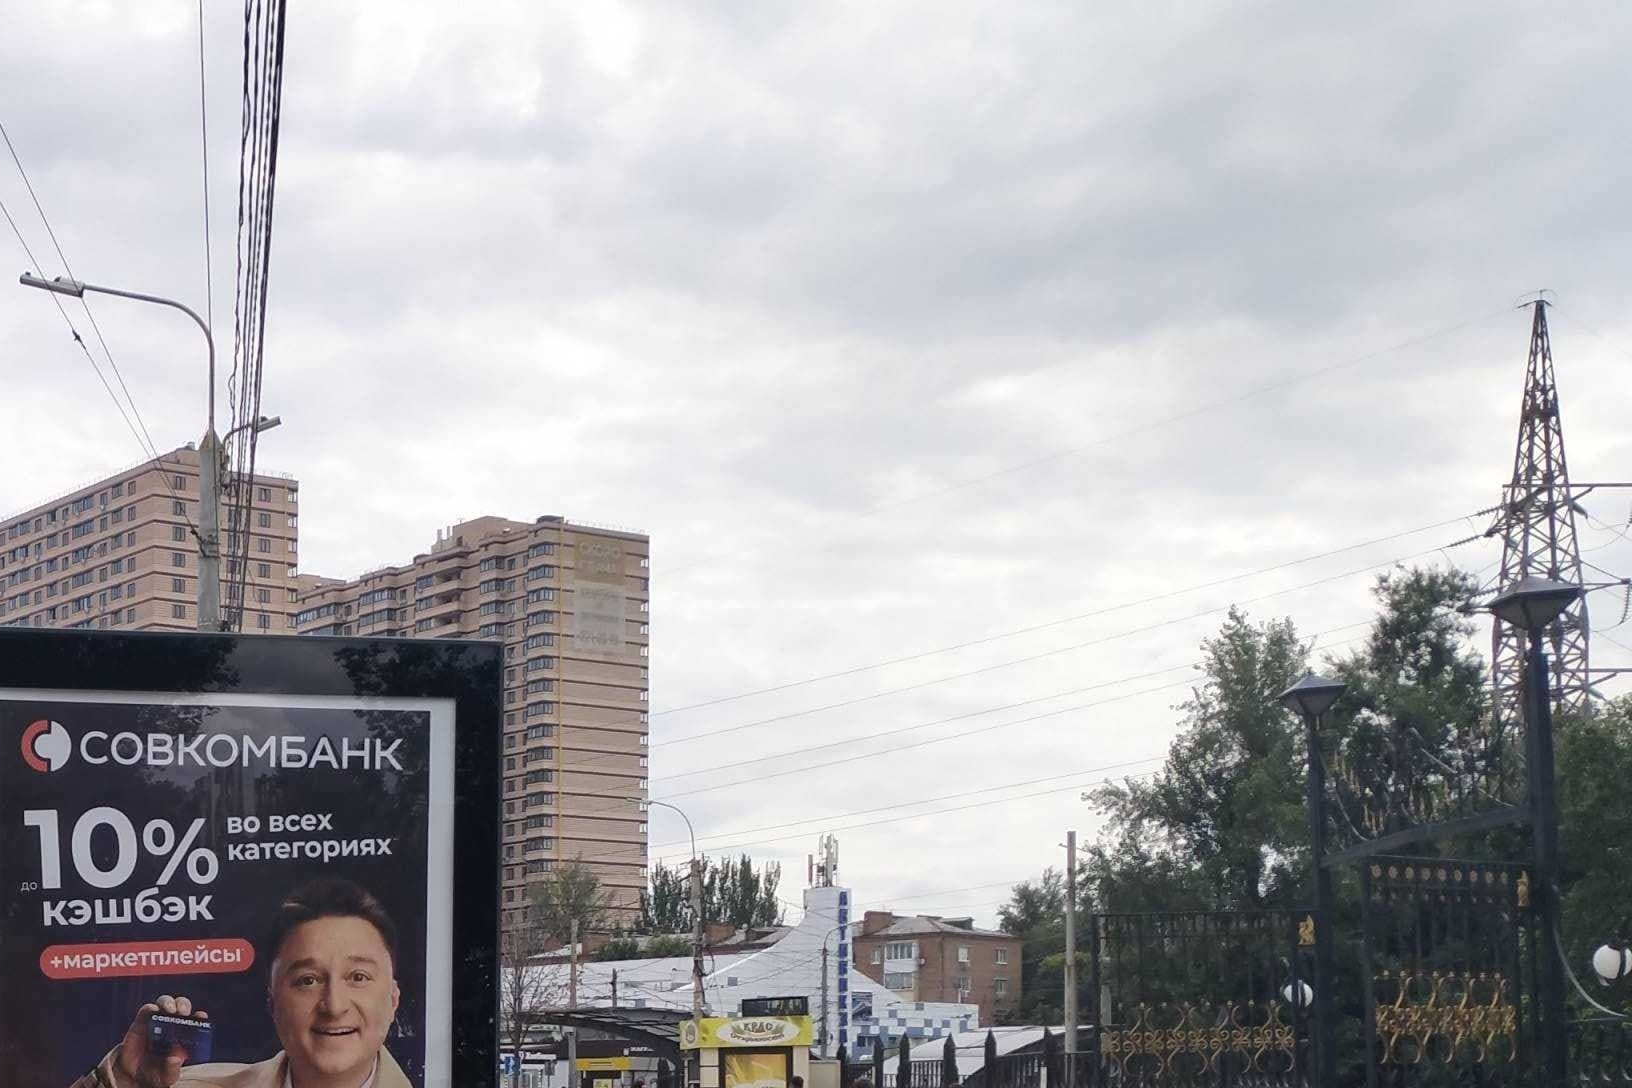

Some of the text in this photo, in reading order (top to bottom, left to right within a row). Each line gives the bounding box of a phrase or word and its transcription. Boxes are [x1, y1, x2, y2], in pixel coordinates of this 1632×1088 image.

[80, 731, 404, 770] СОВКОМБАНК
[227, 813, 333, 834] во всех
[23, 806, 219, 891] 10%
[20, 879, 38, 892] до
[42, 887, 214, 926] кэшбэк
